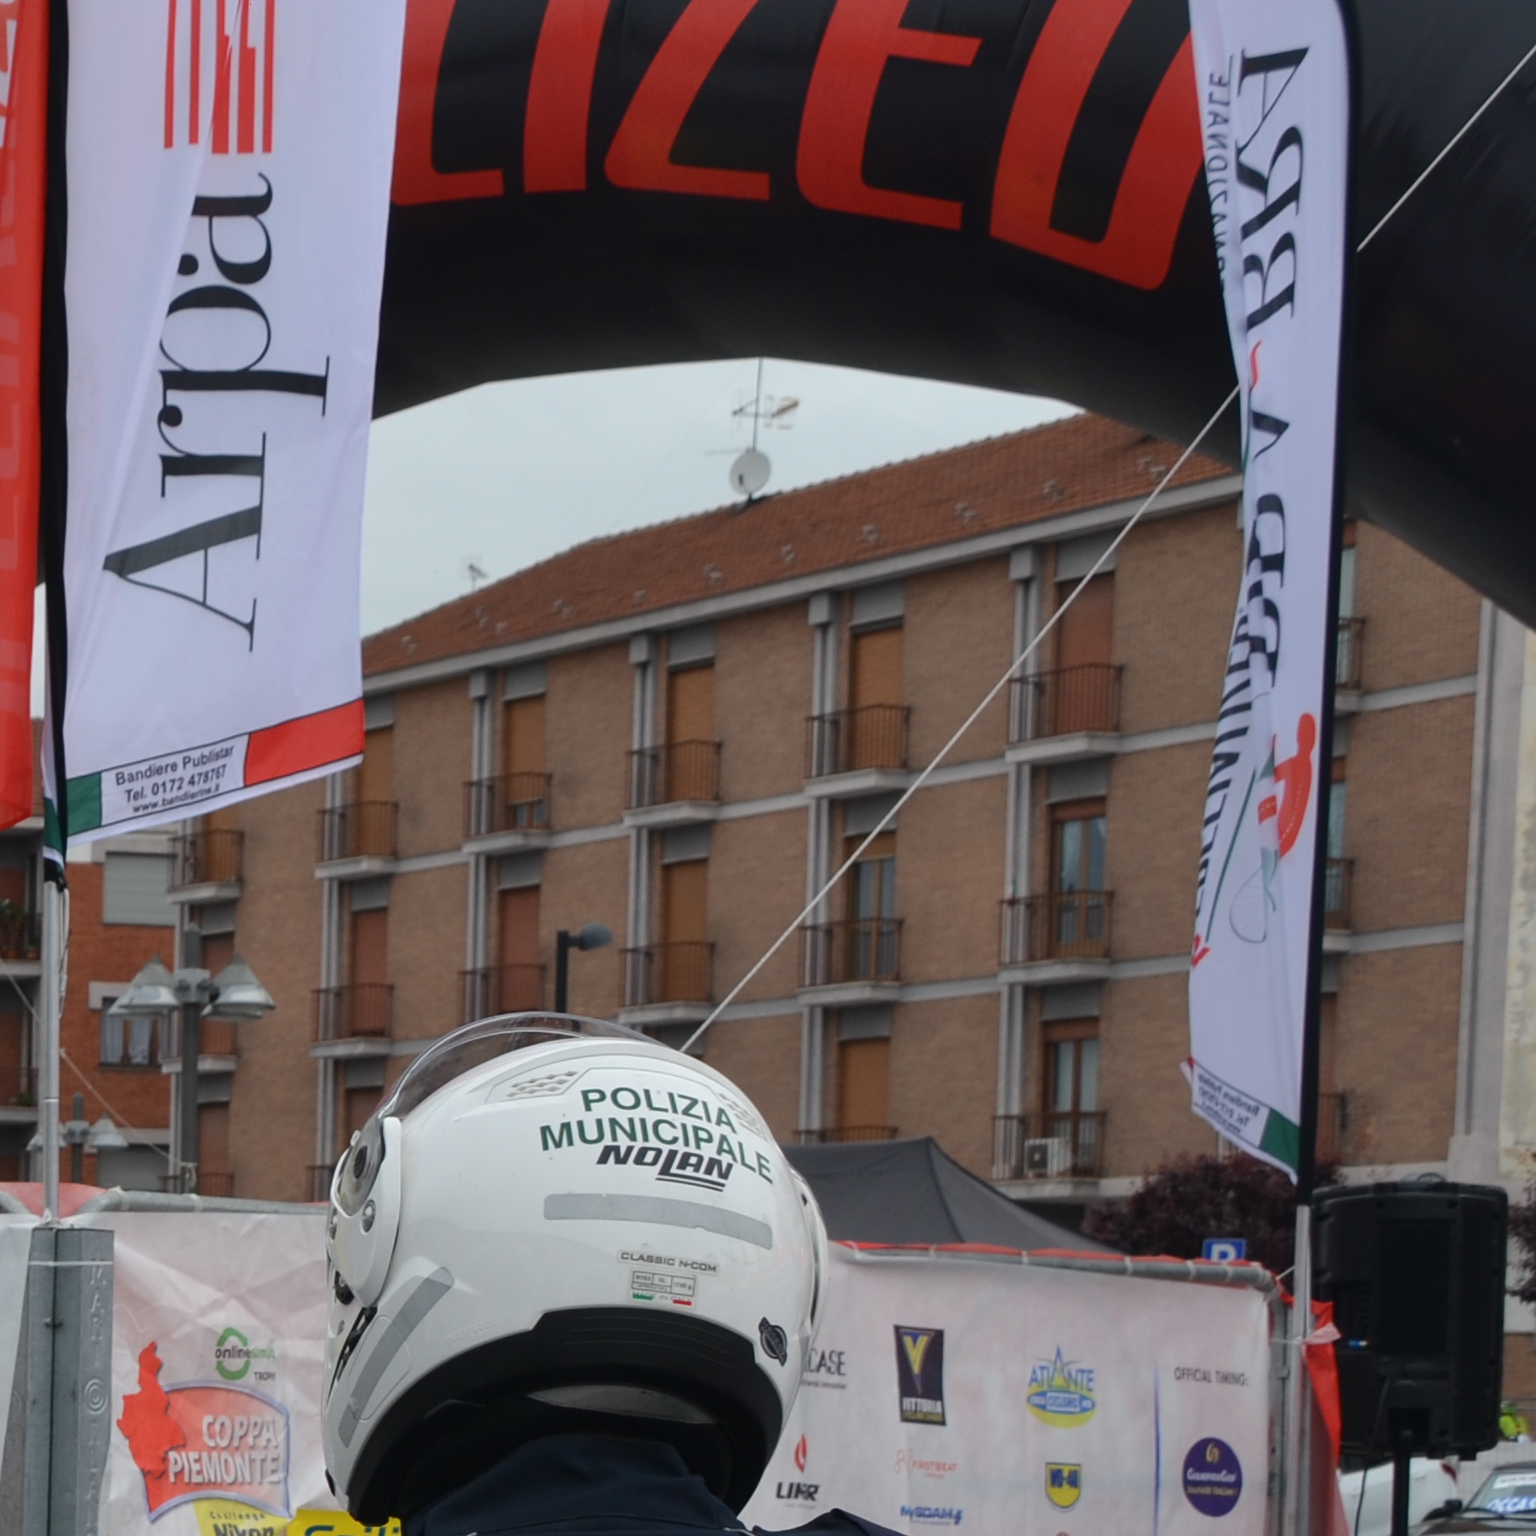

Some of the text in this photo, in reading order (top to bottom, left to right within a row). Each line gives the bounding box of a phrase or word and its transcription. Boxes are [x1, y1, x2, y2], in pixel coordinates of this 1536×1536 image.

[102, 171, 332, 653] Arpa
[115, 745, 235, 786] Bandiere Publistar
[124, 788, 148, 803] Tel.
[151, 777, 184, 796] 0172
[580, 1086, 737, 1135] POLIZIA
[539, 1117, 774, 1185] MUNICIPALE
[595, 1144, 734, 1192] NOLAN
[620, 1251, 717, 1273] CLASSIC N-COM
[1210, 1243, 1237, 1263] P
[1028, 1344, 1095, 1393] ATLANTE
[1174, 1366, 1211, 1384] OFFICIAL
[201, 1413, 279, 1449] COPPA
[168, 1450, 281, 1486] PIEMONTE
[209, 1510, 266, 1522] Challenge
